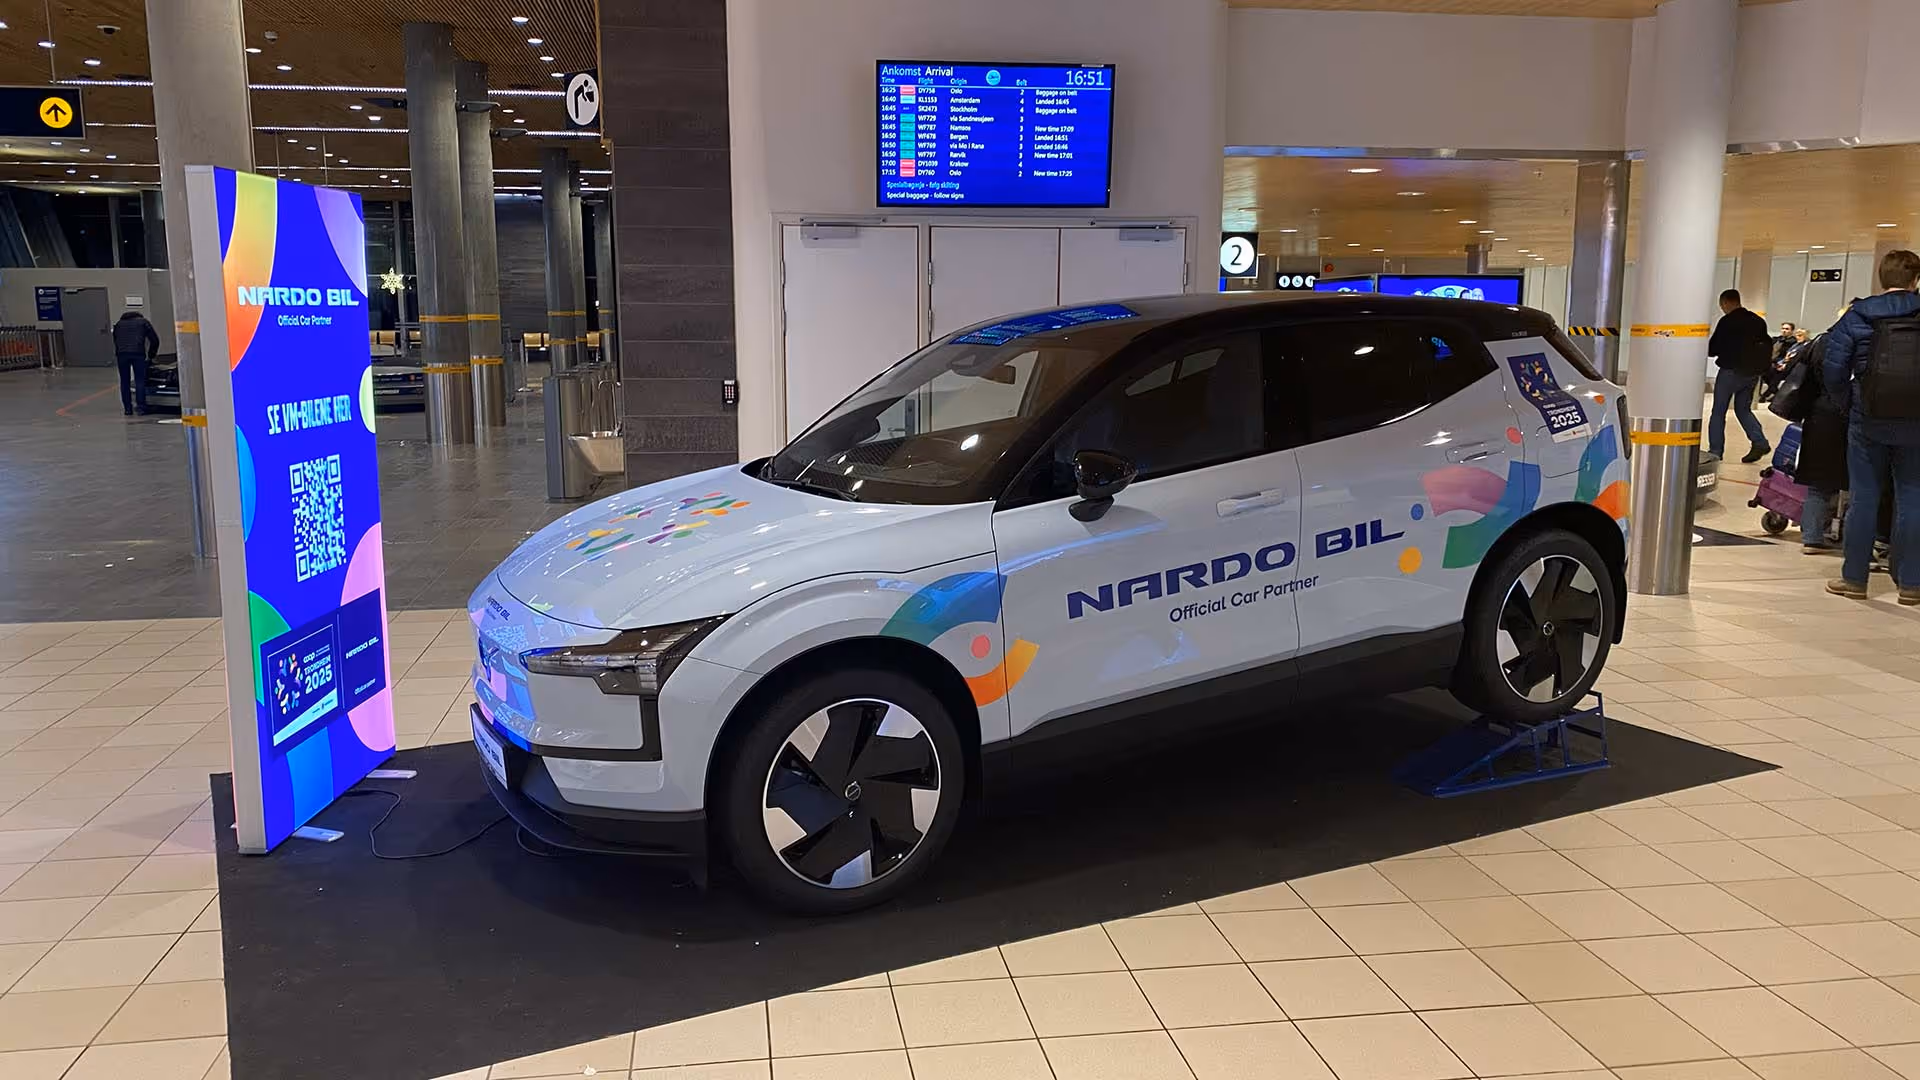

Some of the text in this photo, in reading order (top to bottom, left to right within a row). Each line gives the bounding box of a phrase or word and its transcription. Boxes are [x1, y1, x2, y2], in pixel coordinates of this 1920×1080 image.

[882, 66, 953, 76] Ankomst Arrival
[1066, 70, 1104, 86] 16:51
[1230, 245, 1242, 265] 2
[238, 286, 360, 306] NARDO BIL
[278, 315, 332, 326] Official Car Partner
[267, 394, 352, 435] SE VM-BILENE HER
[1551, 411, 1581, 428] 2025
[1067, 518, 1405, 619] NARDO BIL
[1170, 574, 1319, 622] Official Car Partner
[303, 652, 315, 663] coop
[305, 664, 332, 694] 2025
